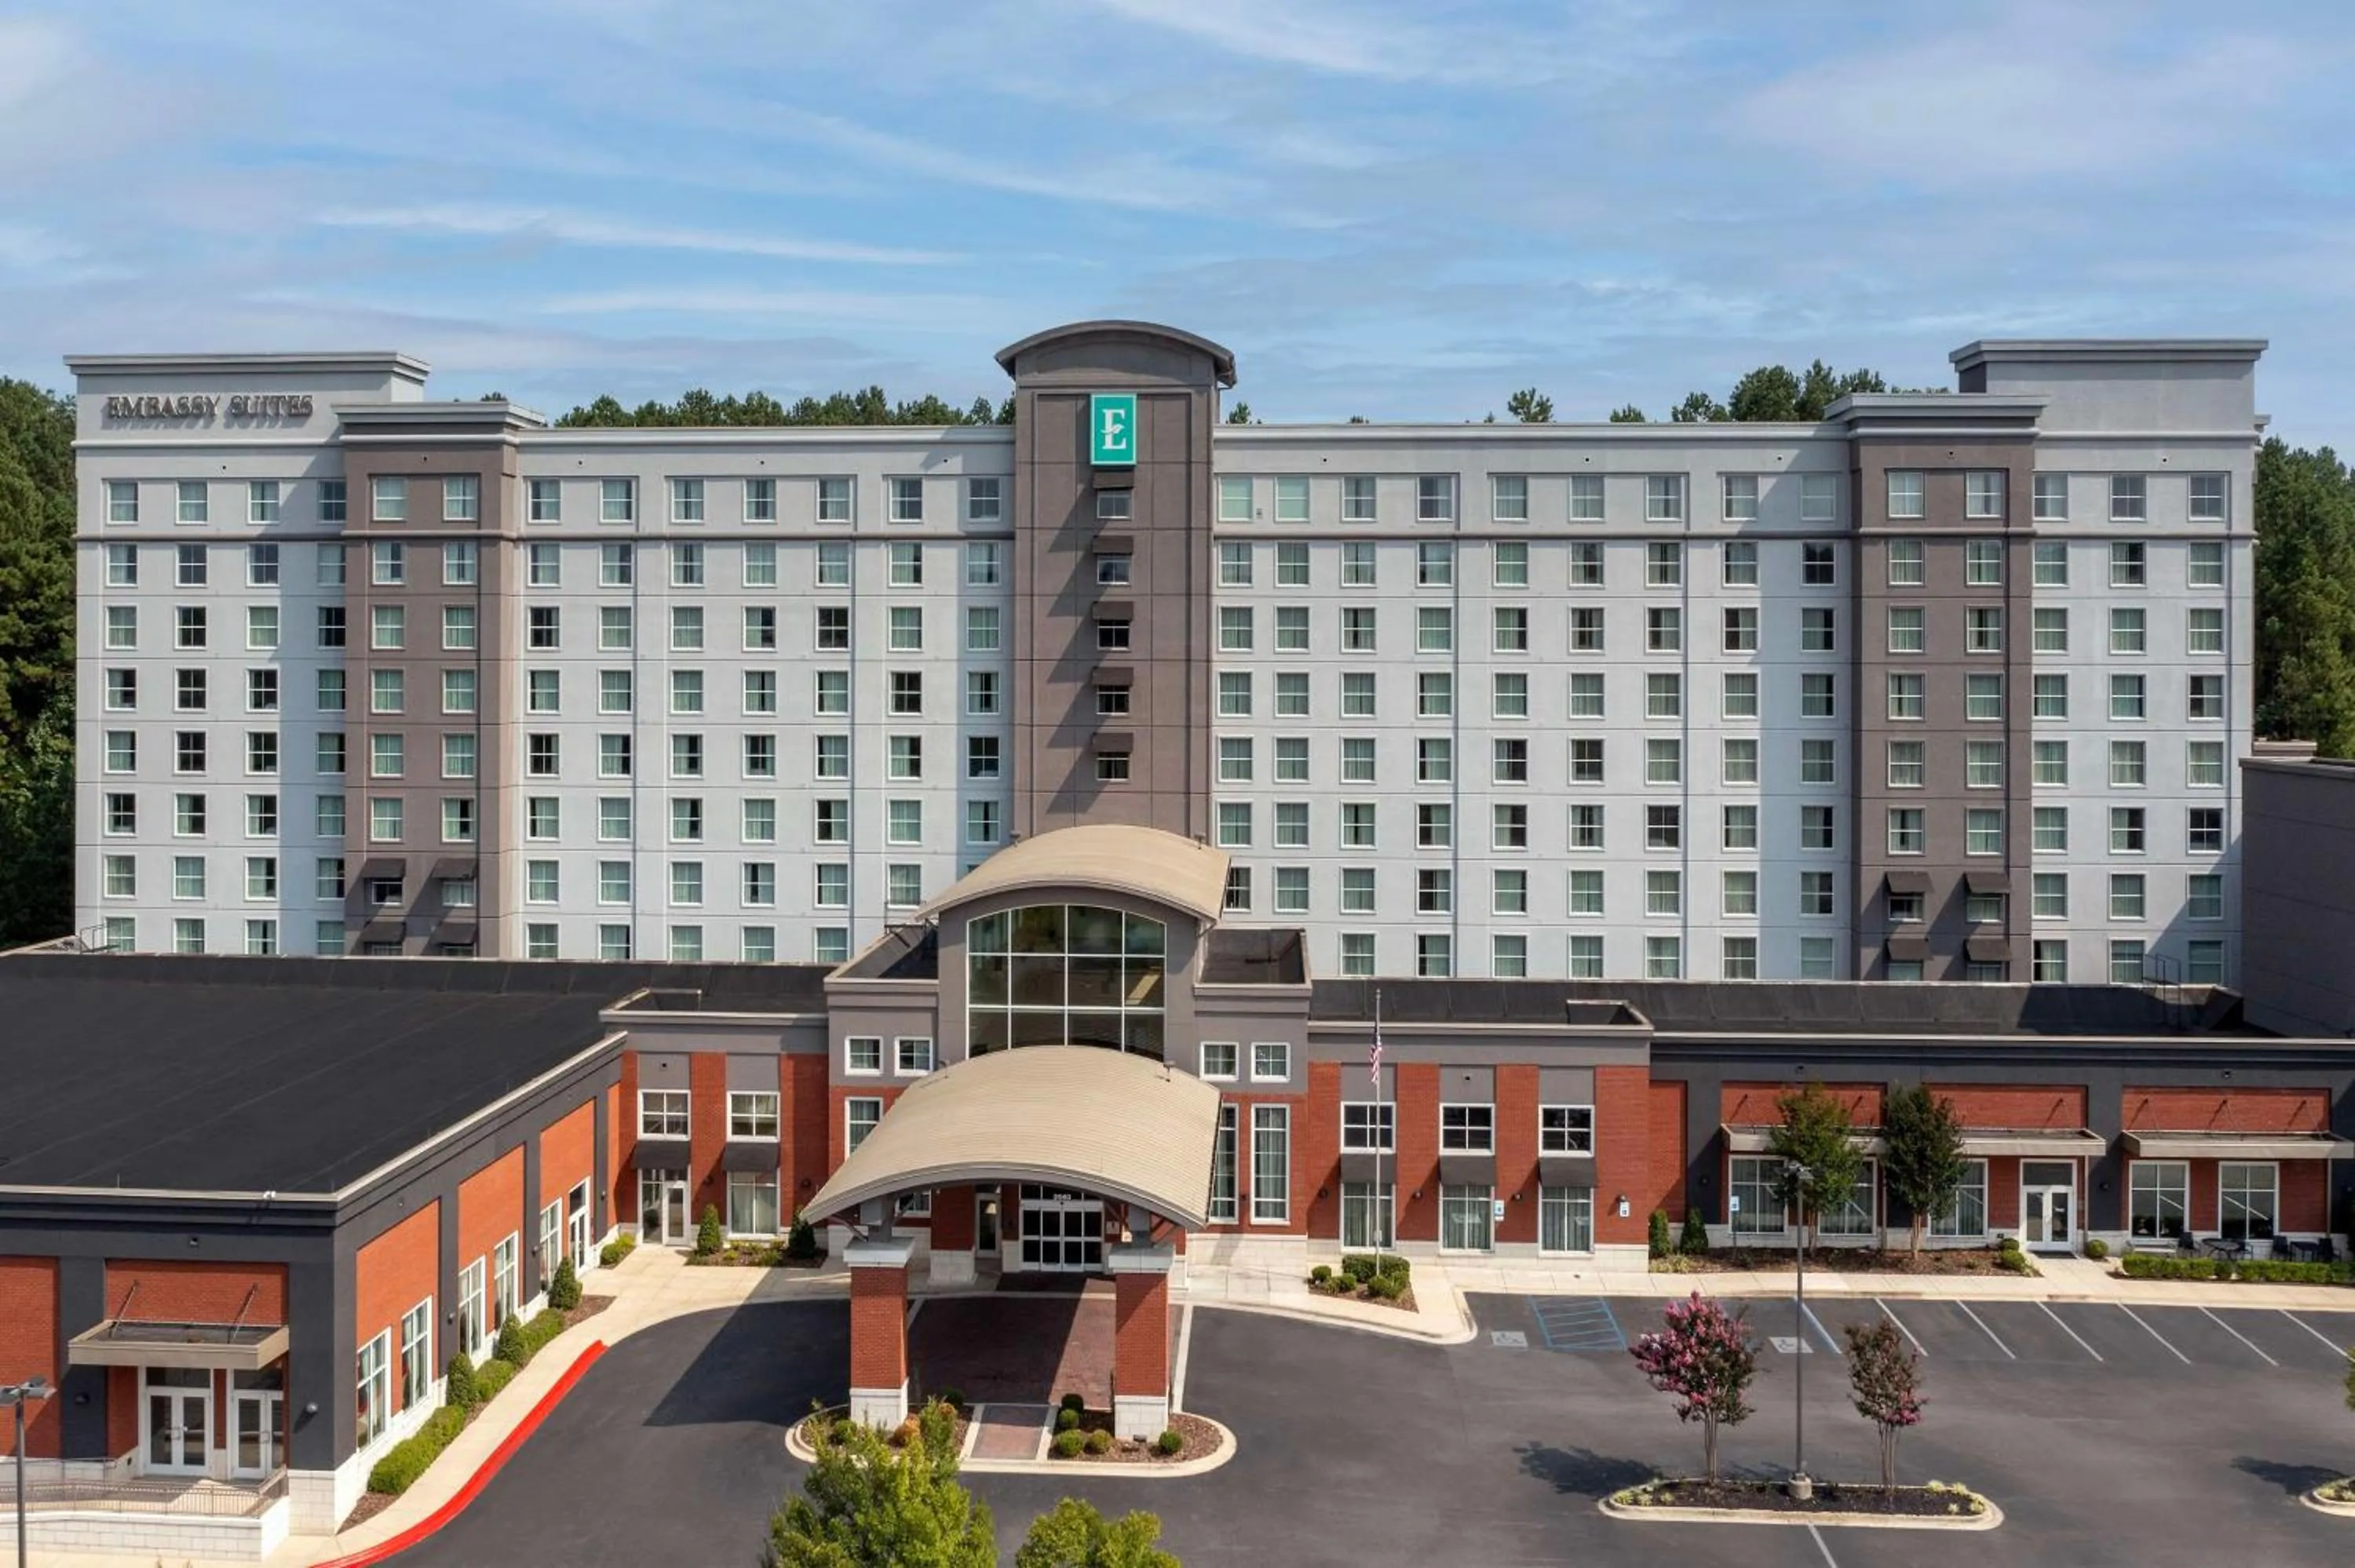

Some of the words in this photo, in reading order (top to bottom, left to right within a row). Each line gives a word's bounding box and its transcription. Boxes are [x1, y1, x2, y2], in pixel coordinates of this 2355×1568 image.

[108, 395, 220, 418] EMBASSY
[231, 395, 313, 418] SUITES
[1100, 409, 1126, 450] E
